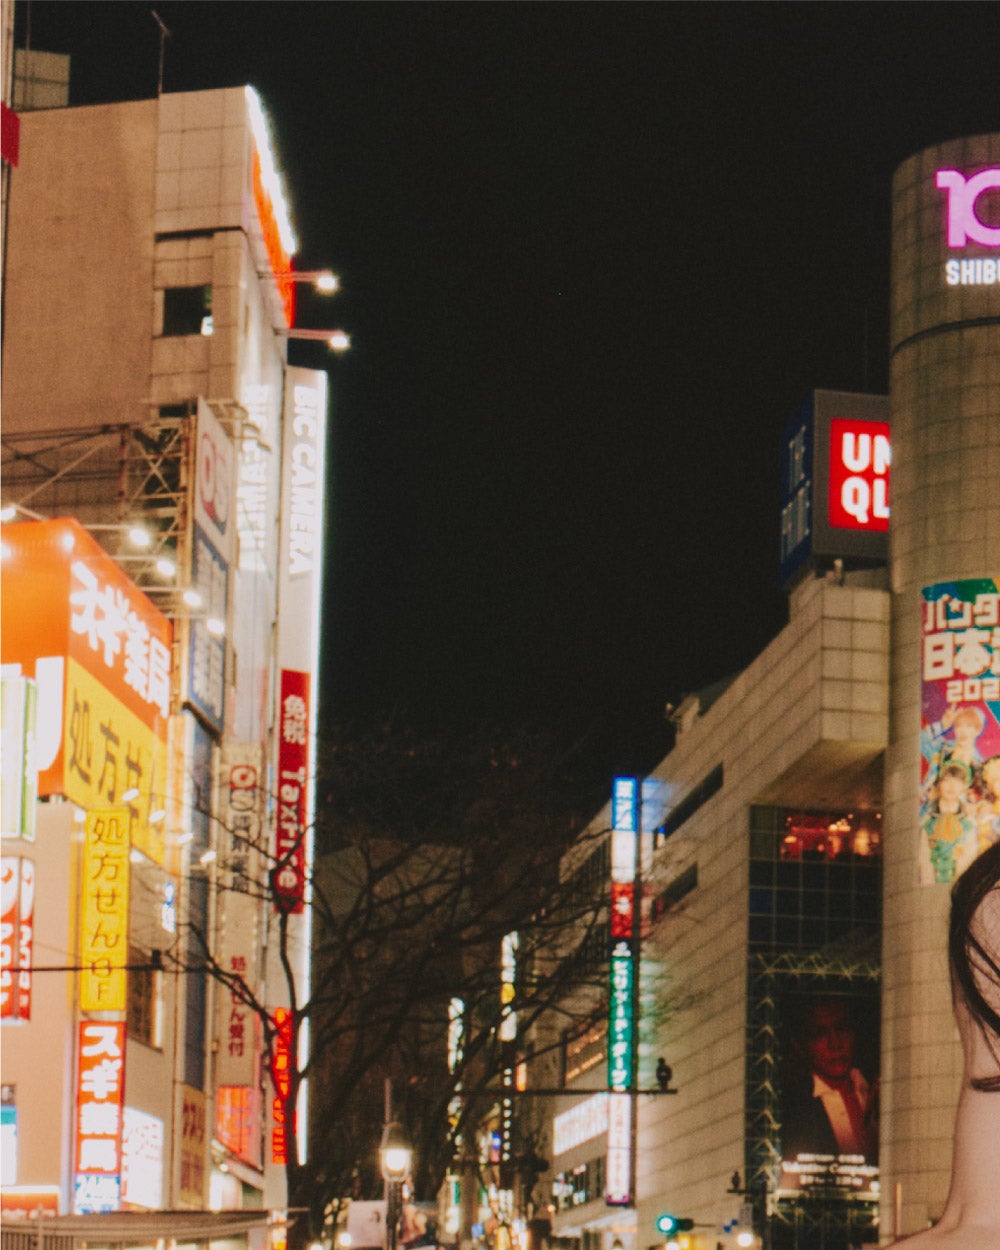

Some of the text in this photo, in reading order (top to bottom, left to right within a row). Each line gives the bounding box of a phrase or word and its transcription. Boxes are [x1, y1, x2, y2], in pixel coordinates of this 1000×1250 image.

[288, 443, 317, 574] CAMERA
[841, 475, 891, 524] QL
[79, 1025, 123, 1172] スギ薬局
